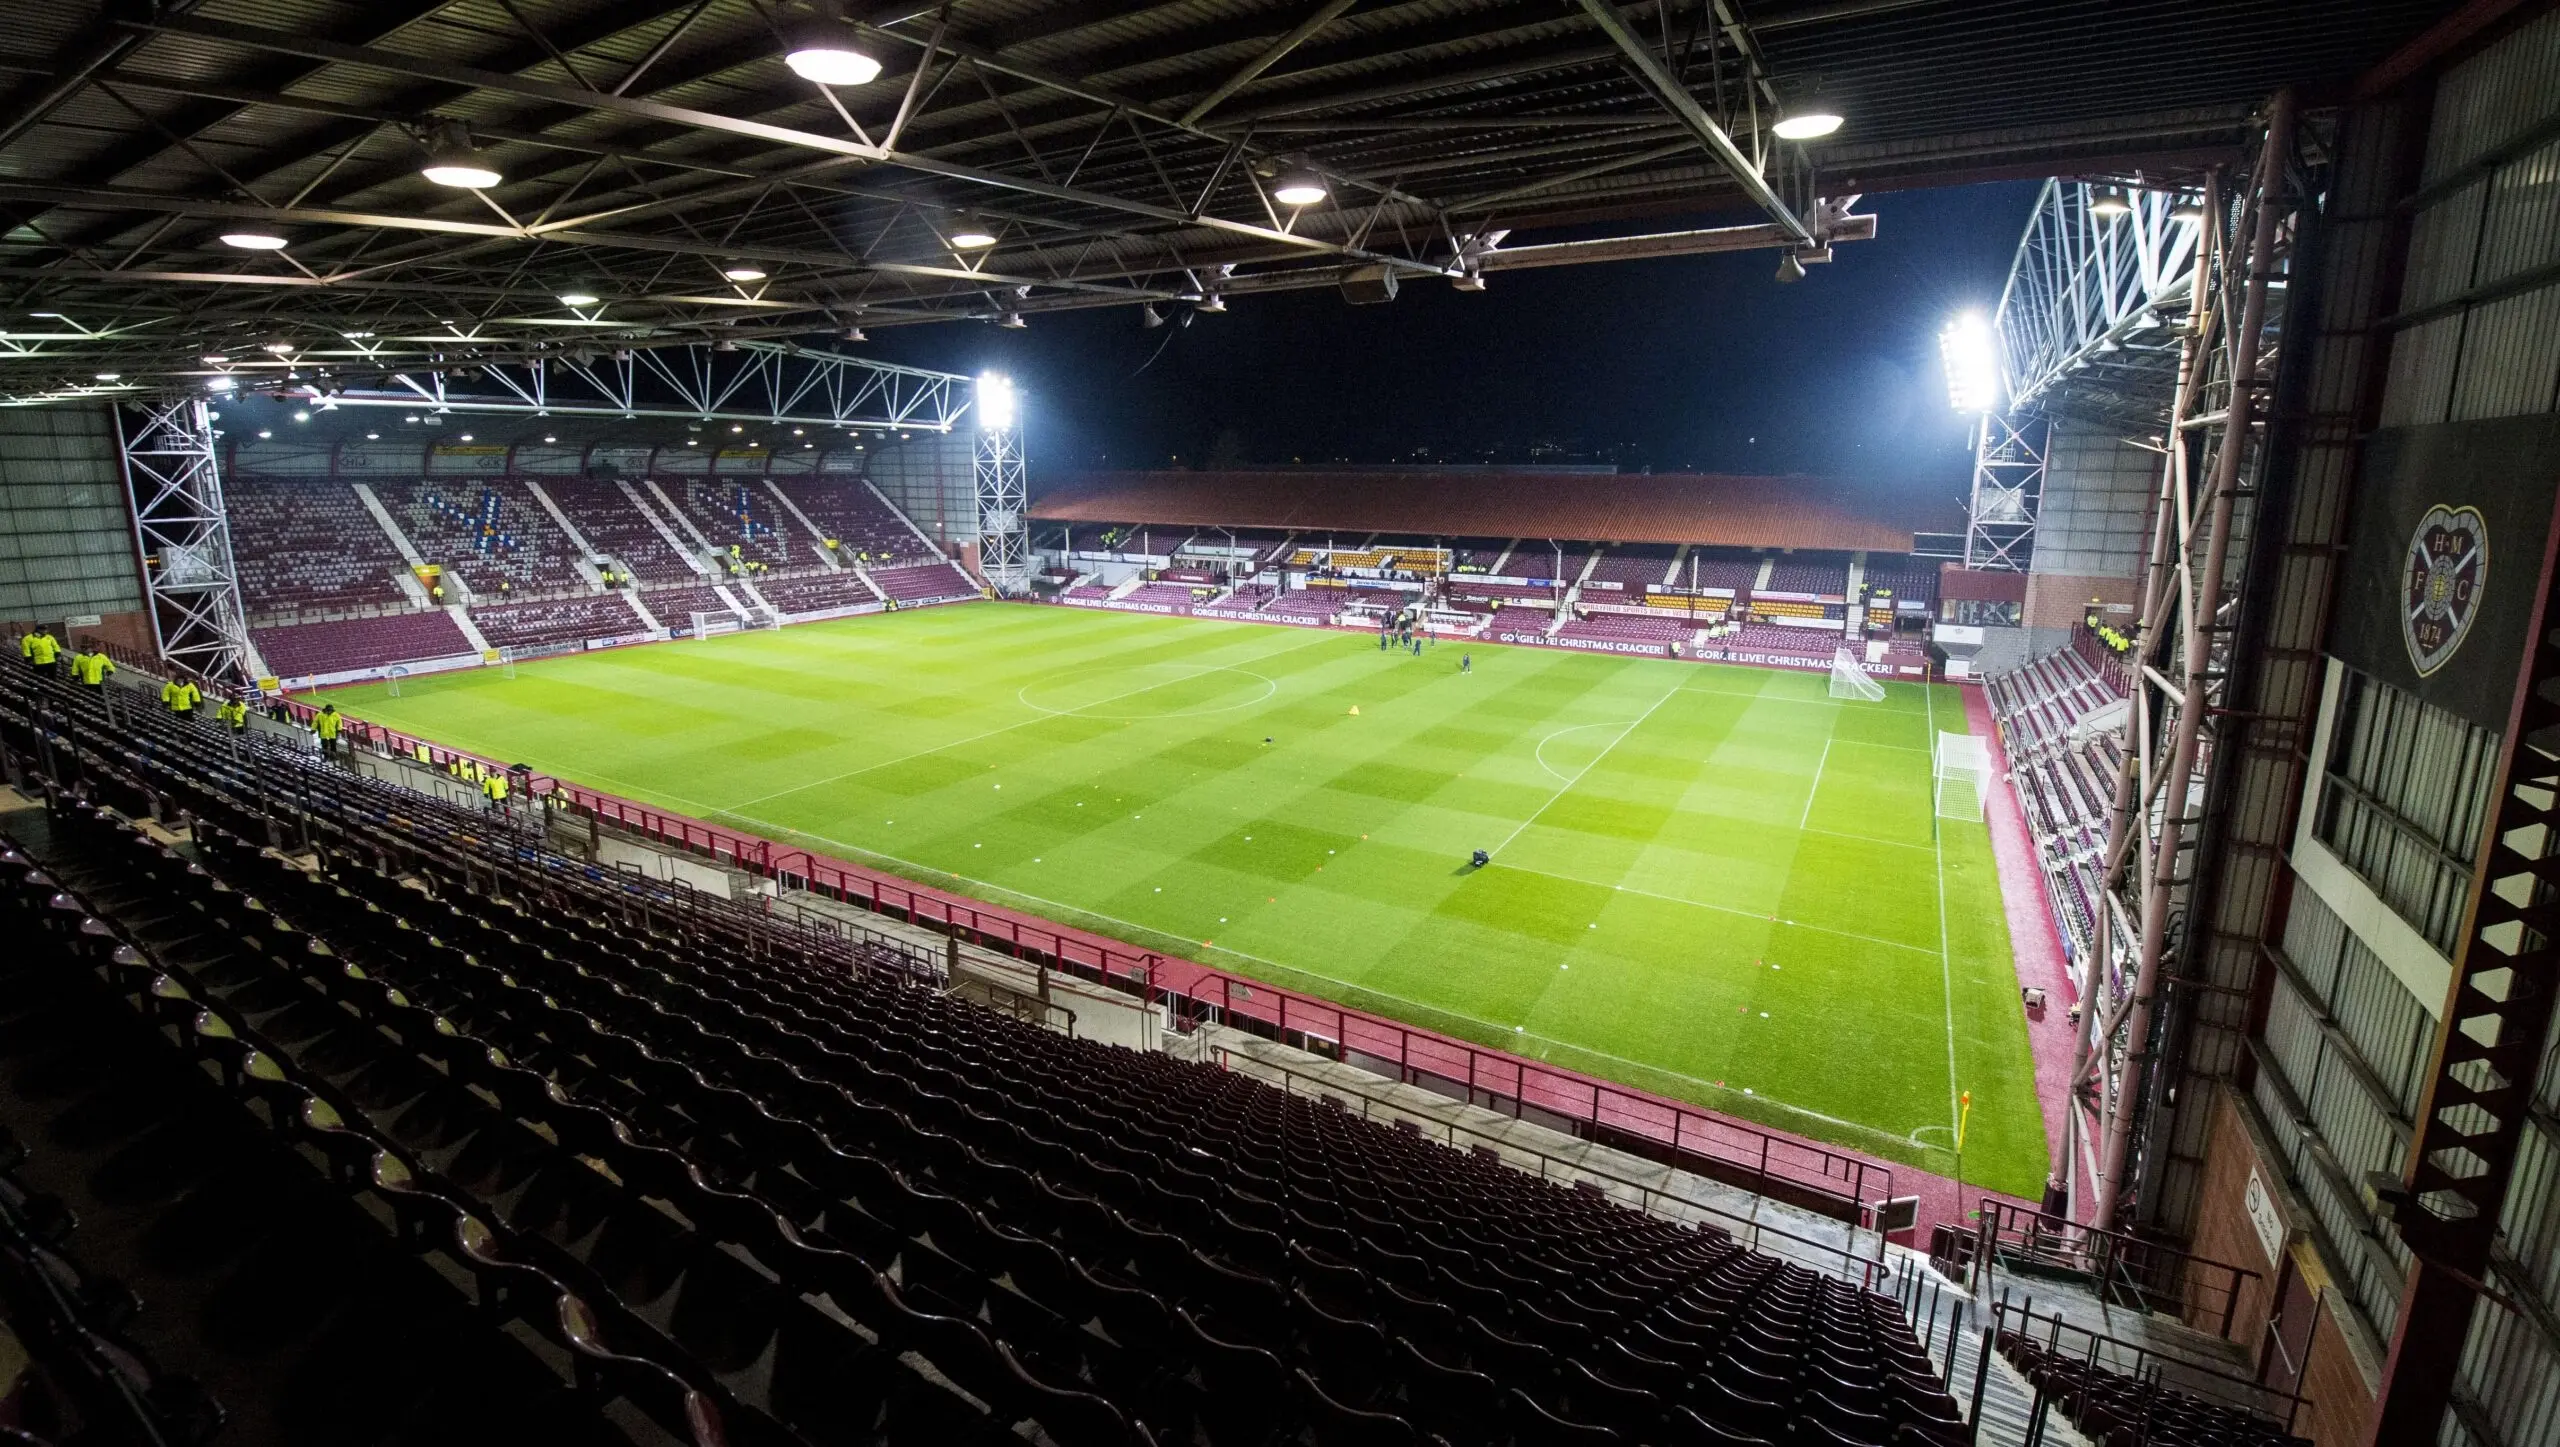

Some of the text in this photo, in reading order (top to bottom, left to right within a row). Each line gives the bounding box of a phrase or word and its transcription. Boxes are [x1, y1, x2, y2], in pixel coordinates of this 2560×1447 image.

[2433, 533, 2464, 555] H M
[2414, 571, 2469, 601] F C
[1062, 597, 1172, 613] GORGIE LIVE! CHRISTMAS CRACKER!
[1191, 608, 1320, 626] GORGIE LIVE! CHRISTMAS CRACKER!
[1500, 632, 1535, 644] GOGIE
[1559, 637, 1614, 651] CHRISTMAS
[1615, 642, 1664, 655] CRACKER!
[2419, 623, 2442, 644] 1874
[1739, 652, 1766, 664] LIVE!
[1767, 655, 1833, 669] CHRISTMAS
